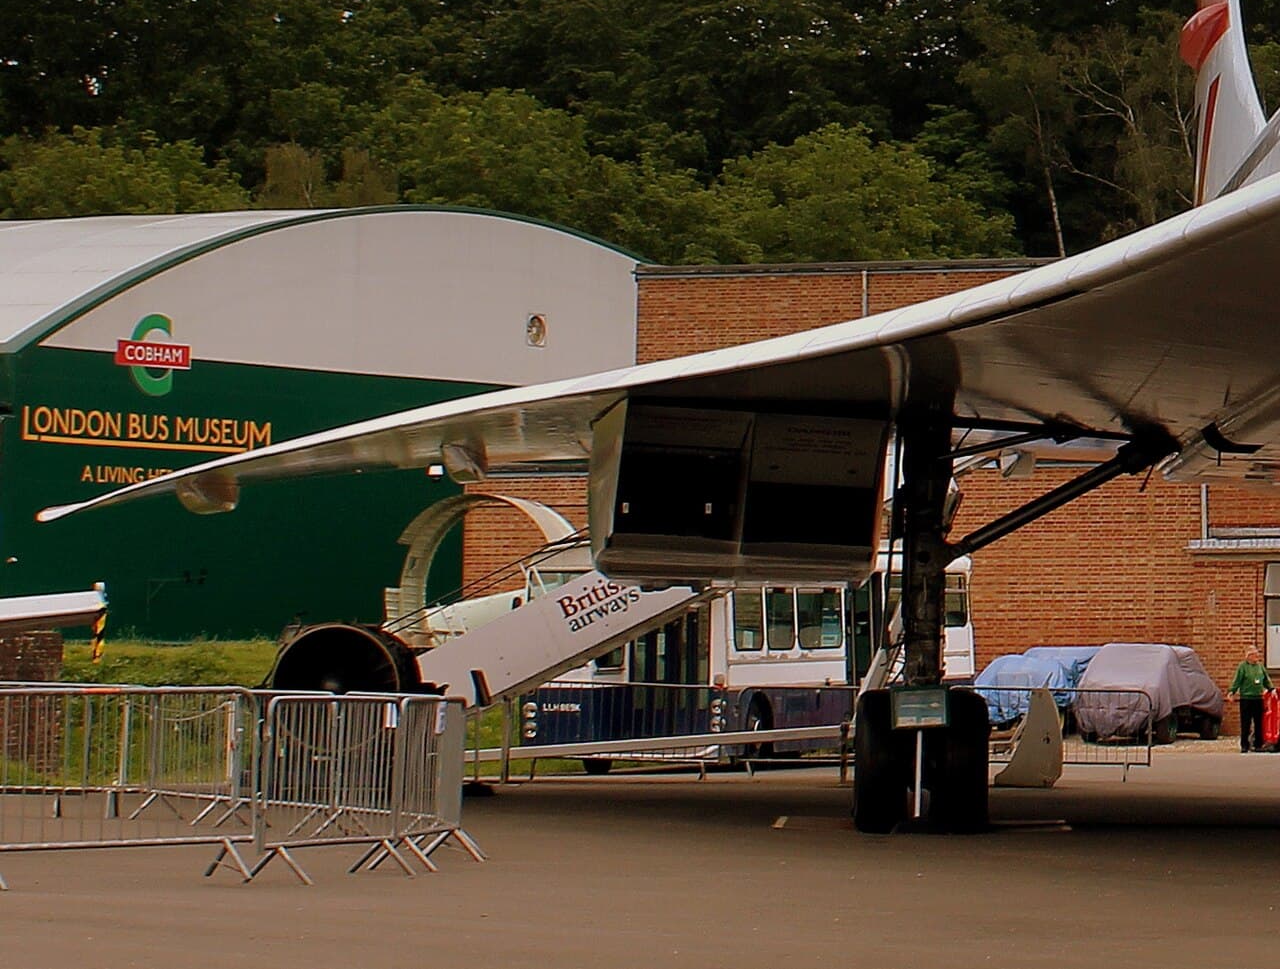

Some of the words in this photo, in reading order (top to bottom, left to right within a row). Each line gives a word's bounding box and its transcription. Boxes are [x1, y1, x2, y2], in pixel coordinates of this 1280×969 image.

[124, 344, 184, 364] COBHAM
[21, 405, 121, 441] LONDON
[127, 412, 169, 440] BUS
[174, 416, 272, 451] MUSEUM
[80, 464, 94, 483] A
[95, 465, 145, 484] LIVING
[556, 578, 627, 619] Britis
[569, 589, 640, 633] airways
